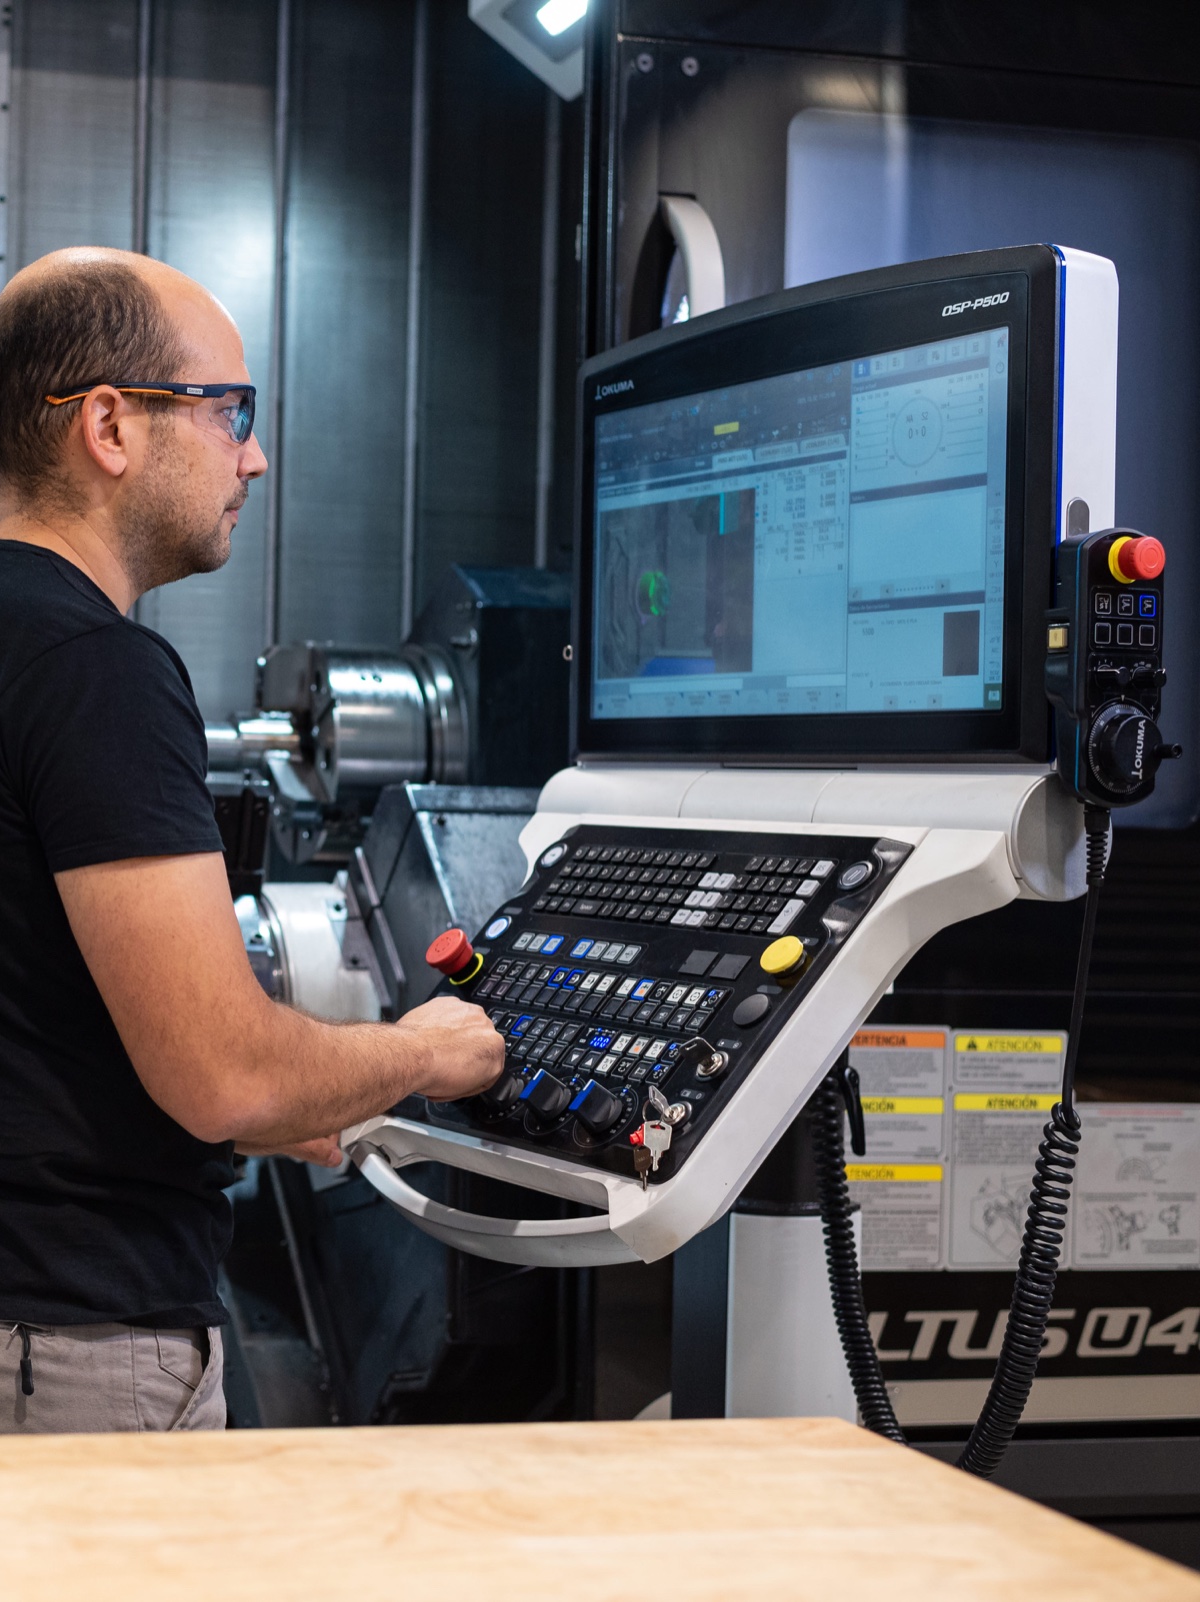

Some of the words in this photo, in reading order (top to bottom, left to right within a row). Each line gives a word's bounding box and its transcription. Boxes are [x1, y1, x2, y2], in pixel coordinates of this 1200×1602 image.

[941, 291, 1011, 317] OSP-P500
[600, 379, 635, 397] OKUMA
[1134, 719, 1146, 769] OKUMA
[986, 1036, 1042, 1052] ATENCIÓN
[985, 1095, 1038, 1110] ATENCIÓN
